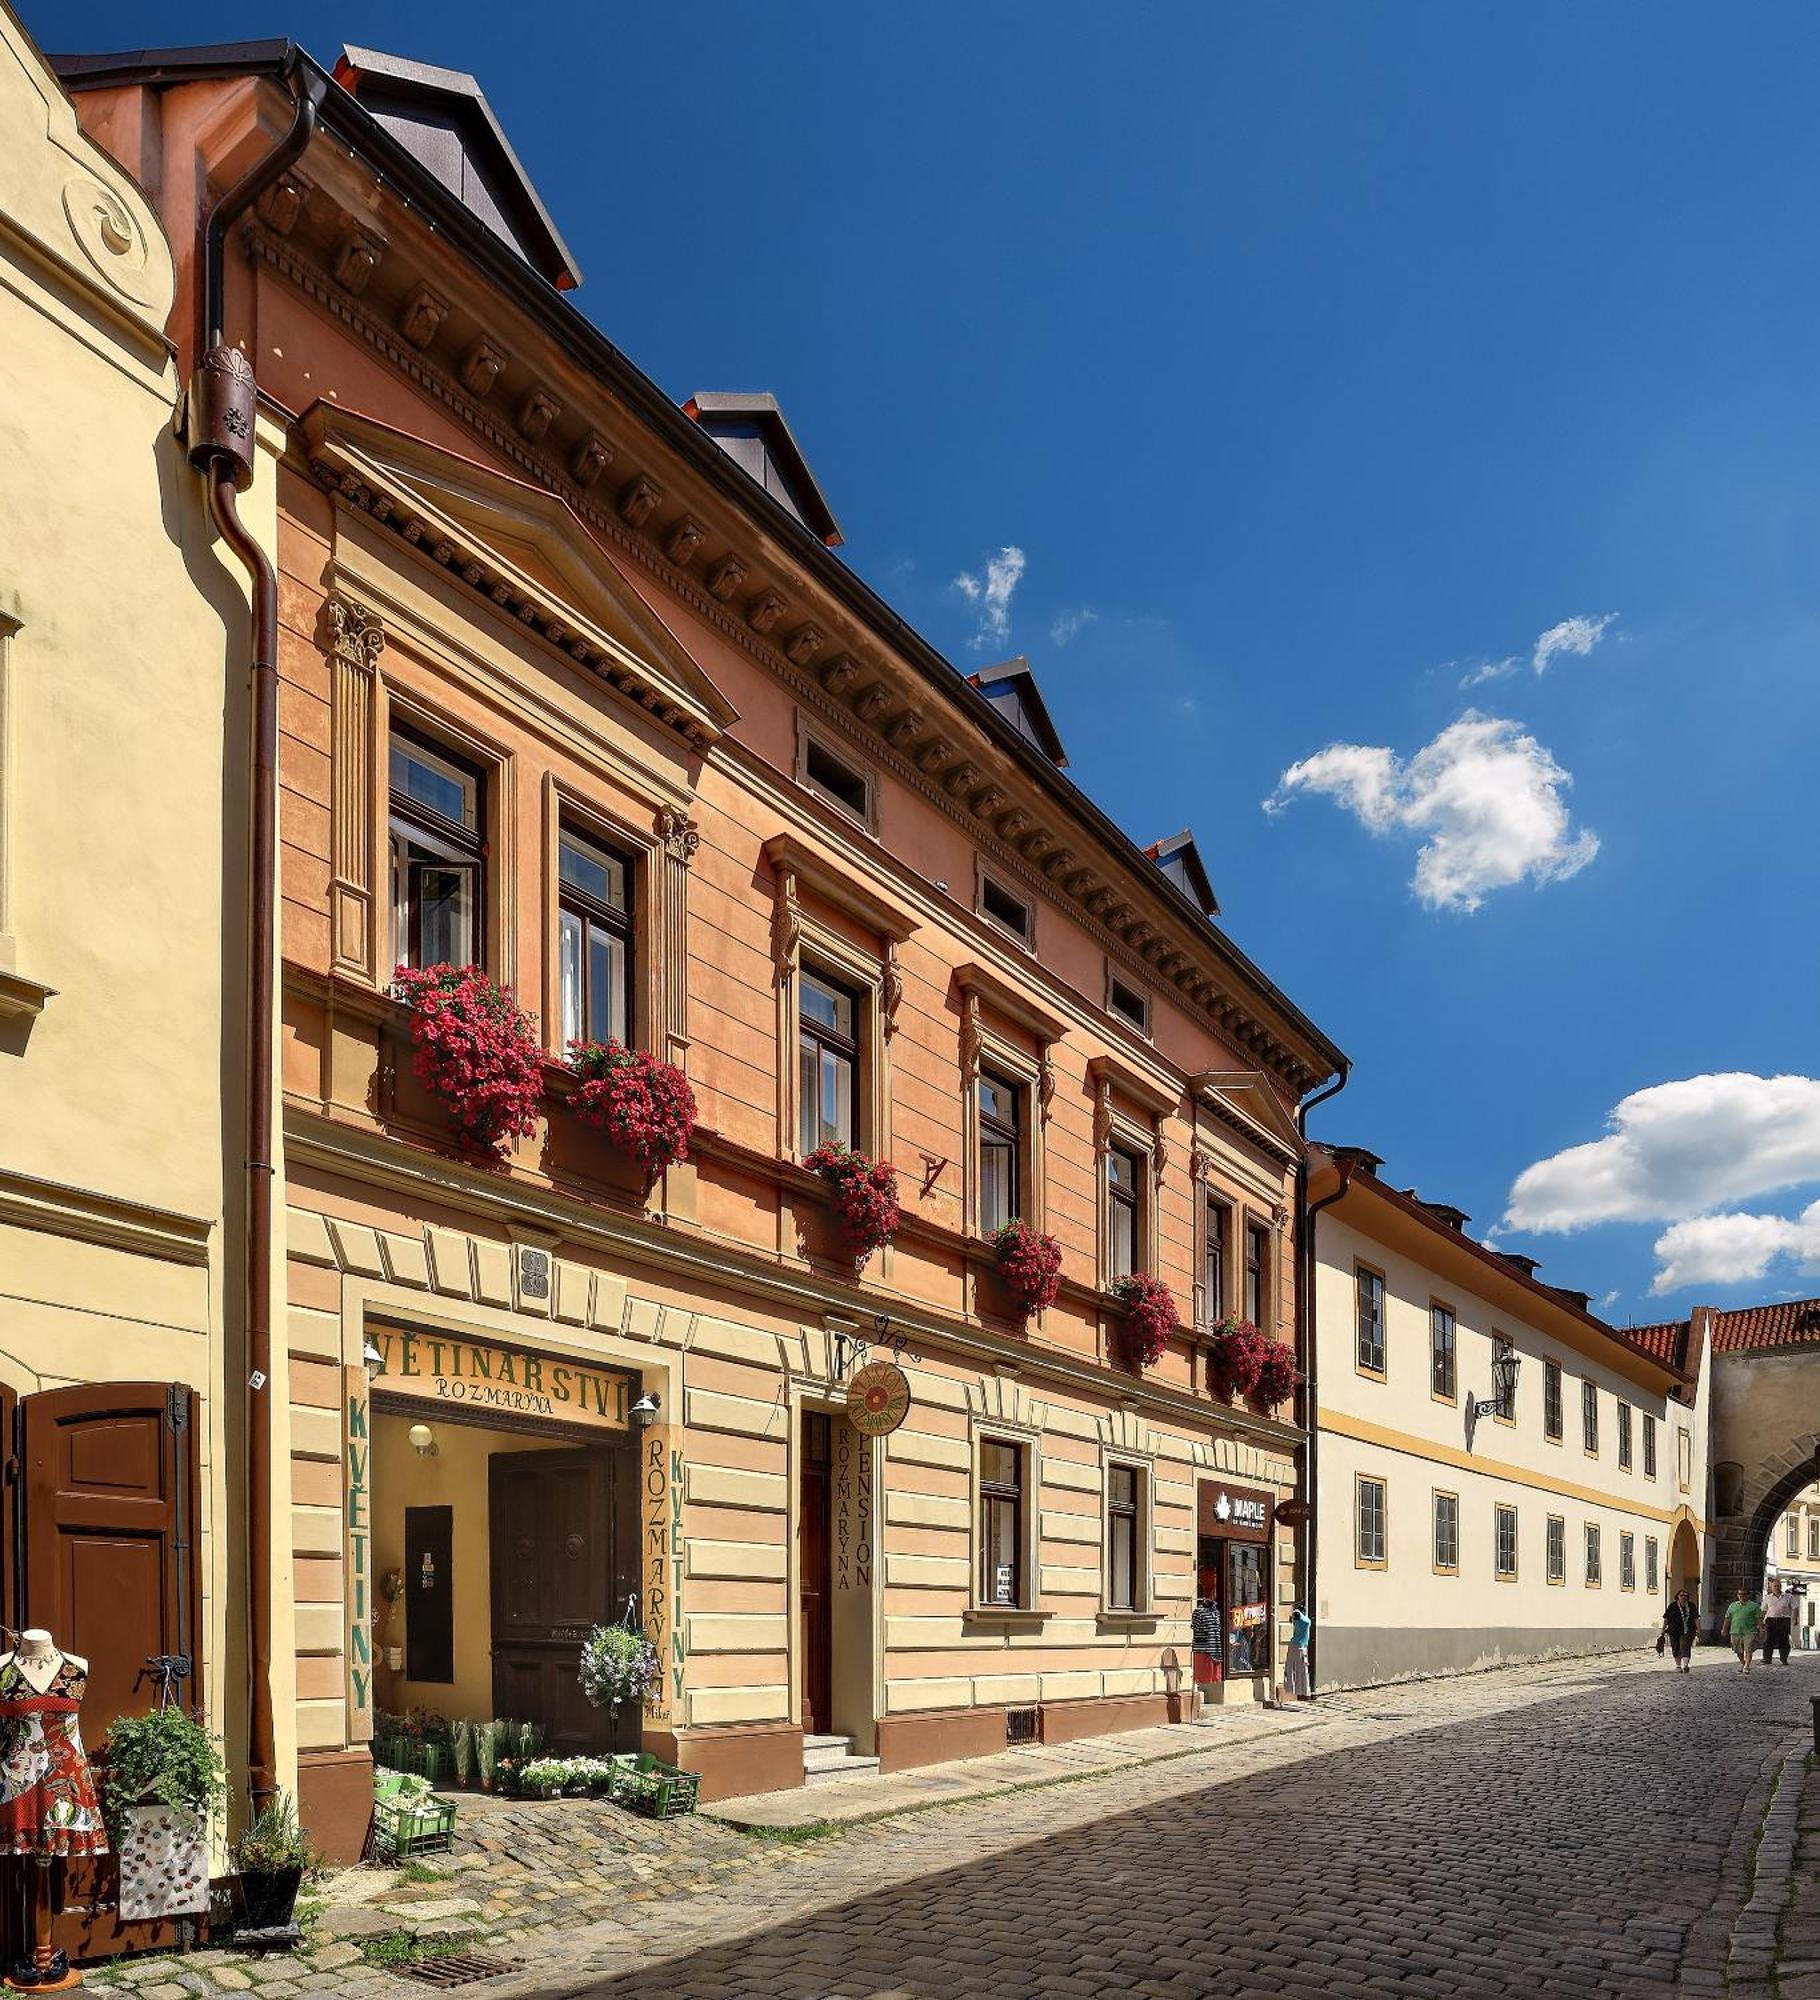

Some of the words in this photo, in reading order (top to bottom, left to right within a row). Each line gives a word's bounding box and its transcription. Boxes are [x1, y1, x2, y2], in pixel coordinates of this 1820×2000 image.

[363, 1330, 629, 1424] VĚTINAŘSTVÍ
[435, 1378, 554, 1414] ROZMARÝNA
[349, 1395, 370, 1709] KVĚTINY
[670, 1450, 684, 1699] KVĚTINY
[836, 1428, 852, 1590] ROZMARÝNA
[856, 1431, 871, 1586] PENSION
[1233, 1498, 1266, 1521] MAPLE
